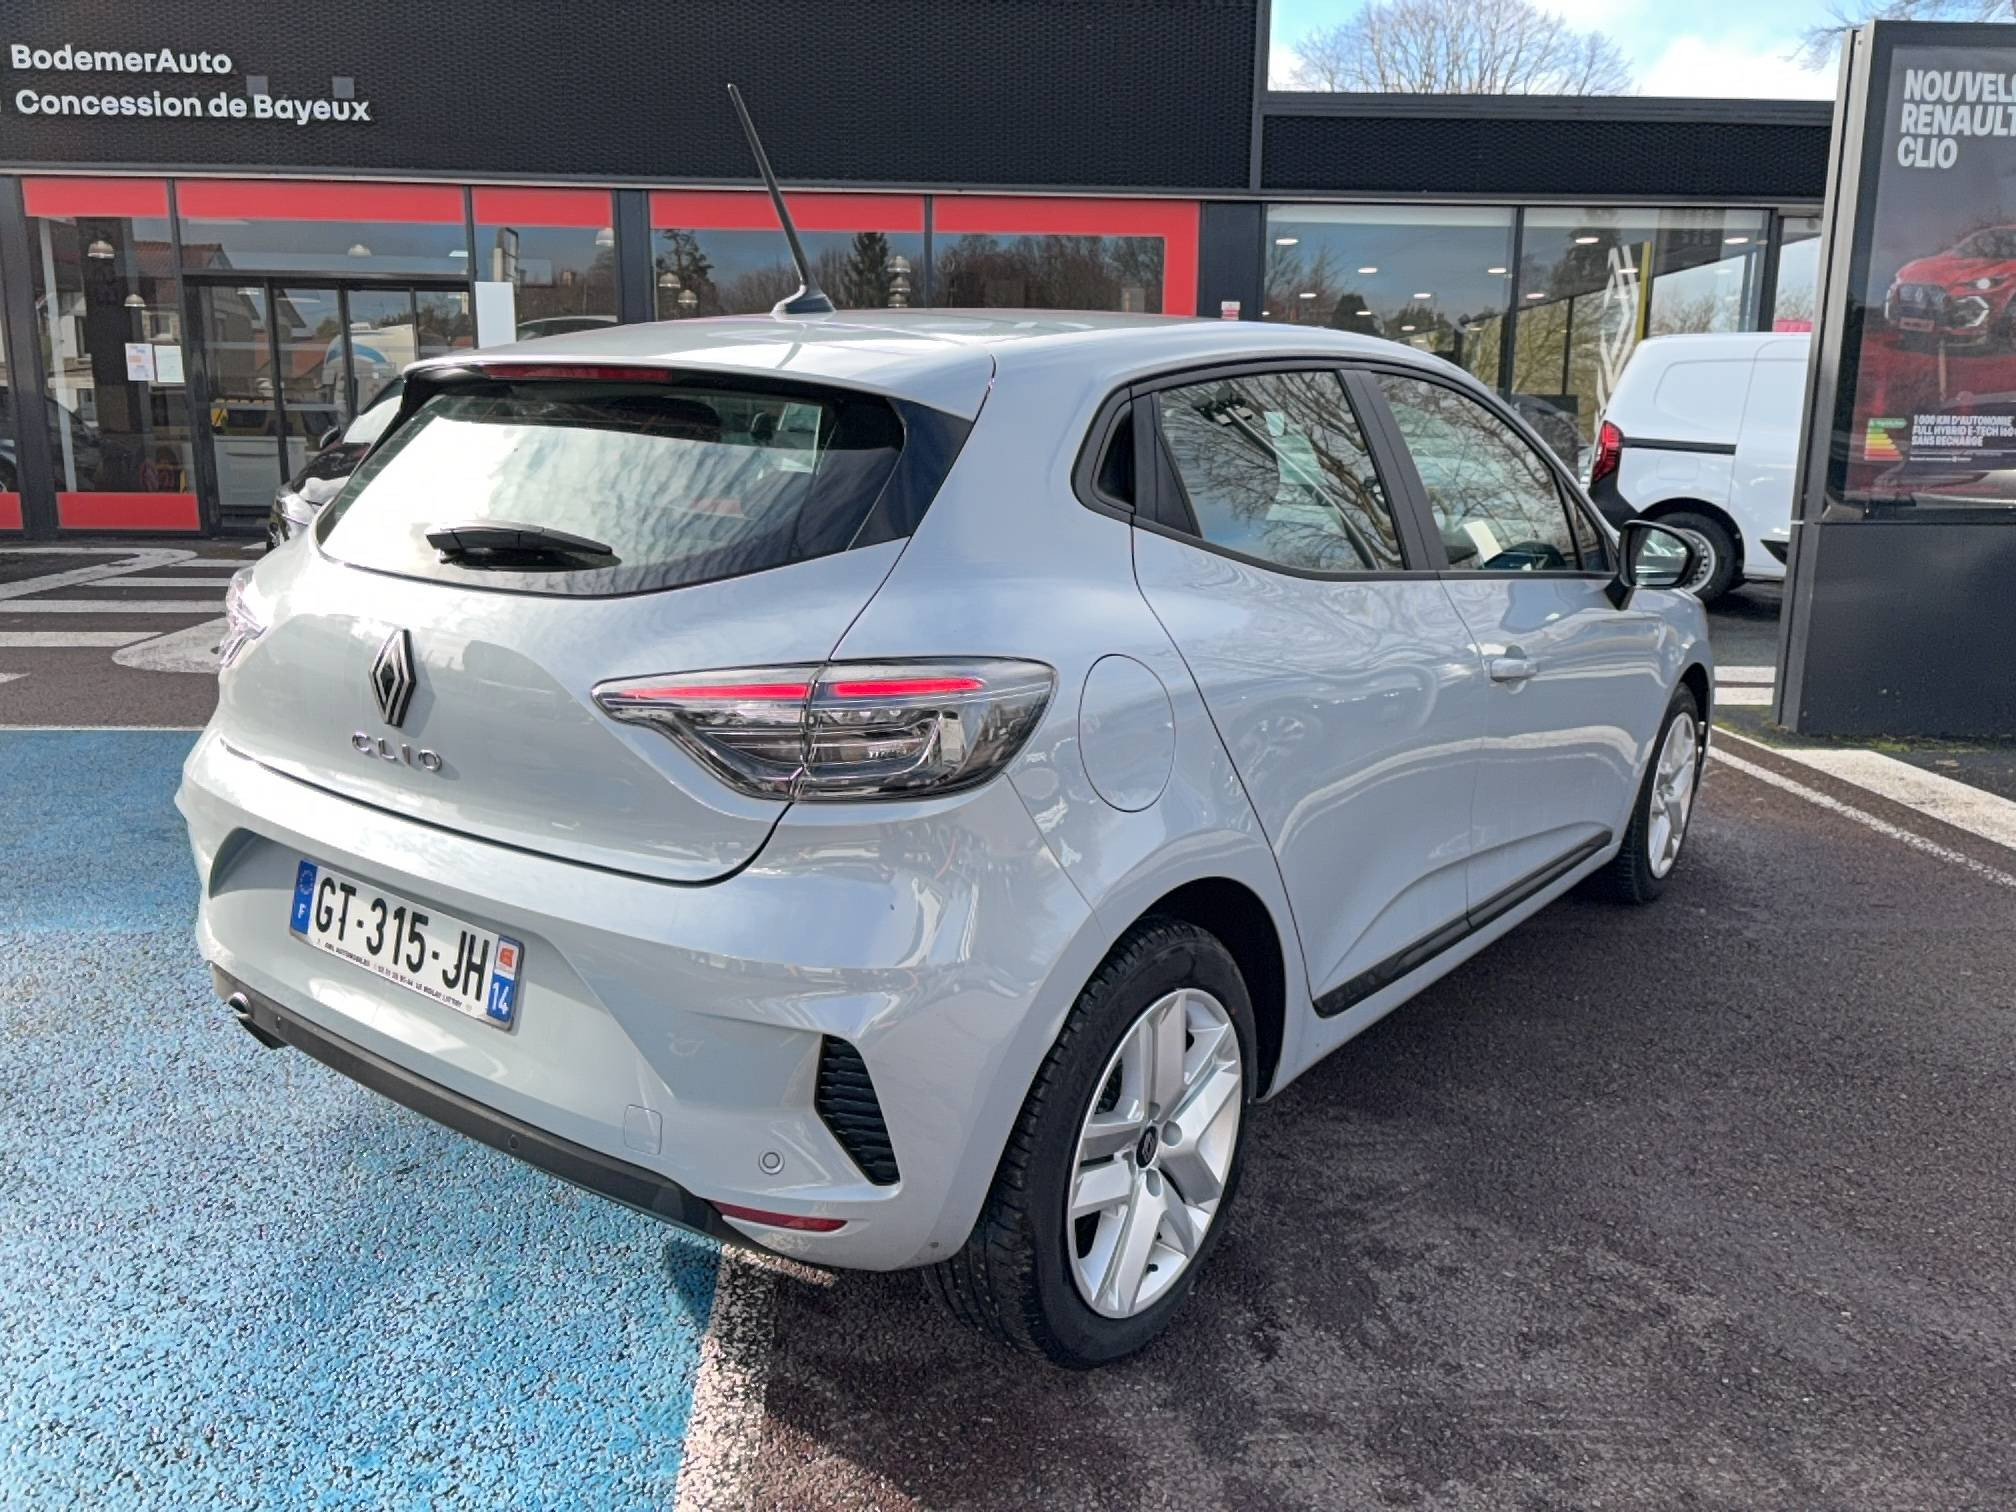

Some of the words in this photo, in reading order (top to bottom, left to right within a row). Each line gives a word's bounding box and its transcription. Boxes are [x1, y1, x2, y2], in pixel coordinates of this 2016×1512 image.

[11, 44, 232, 74] BodemerAuto
[1904, 69, 2016, 103] NOUVEL
[15, 90, 202, 117] Concession
[208, 92, 247, 118] de
[253, 94, 371, 125] Bayeux
[1898, 136, 1958, 169] CLIO
[1912, 425, 1934, 435] FULL
[1934, 425, 1966, 436] HYBRID
[1936, 435, 1983, 447] RECHARGE
[352, 732, 442, 773] CLIO
[298, 903, 307, 919] F
[316, 876, 490, 1002] GT-315-JH
[492, 981, 509, 1015] 14
